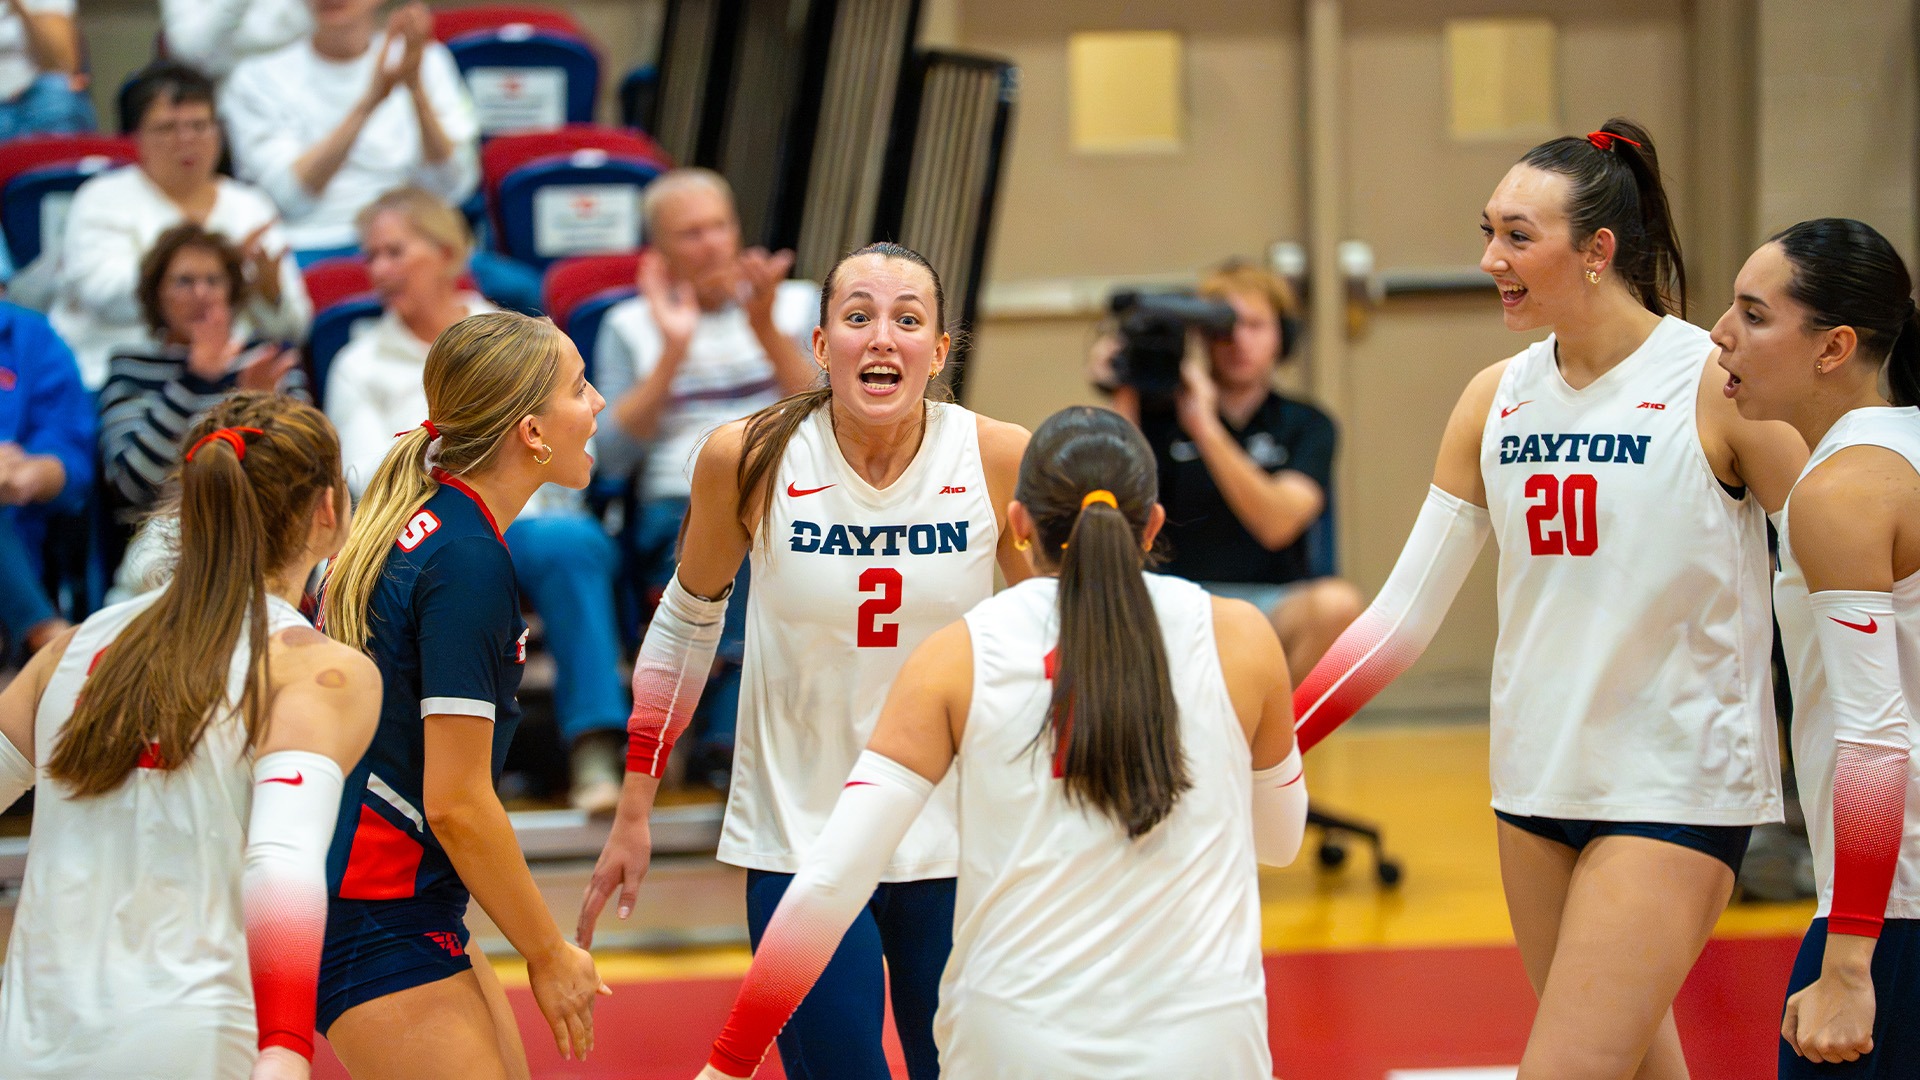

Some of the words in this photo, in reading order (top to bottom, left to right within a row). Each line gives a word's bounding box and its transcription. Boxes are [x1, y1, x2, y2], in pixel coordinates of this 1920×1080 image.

[1499, 433, 1652, 465] DAYTON
[788, 519, 970, 556] DAYTON
[1524, 473, 1599, 557] 20
[856, 567, 903, 648] 2
